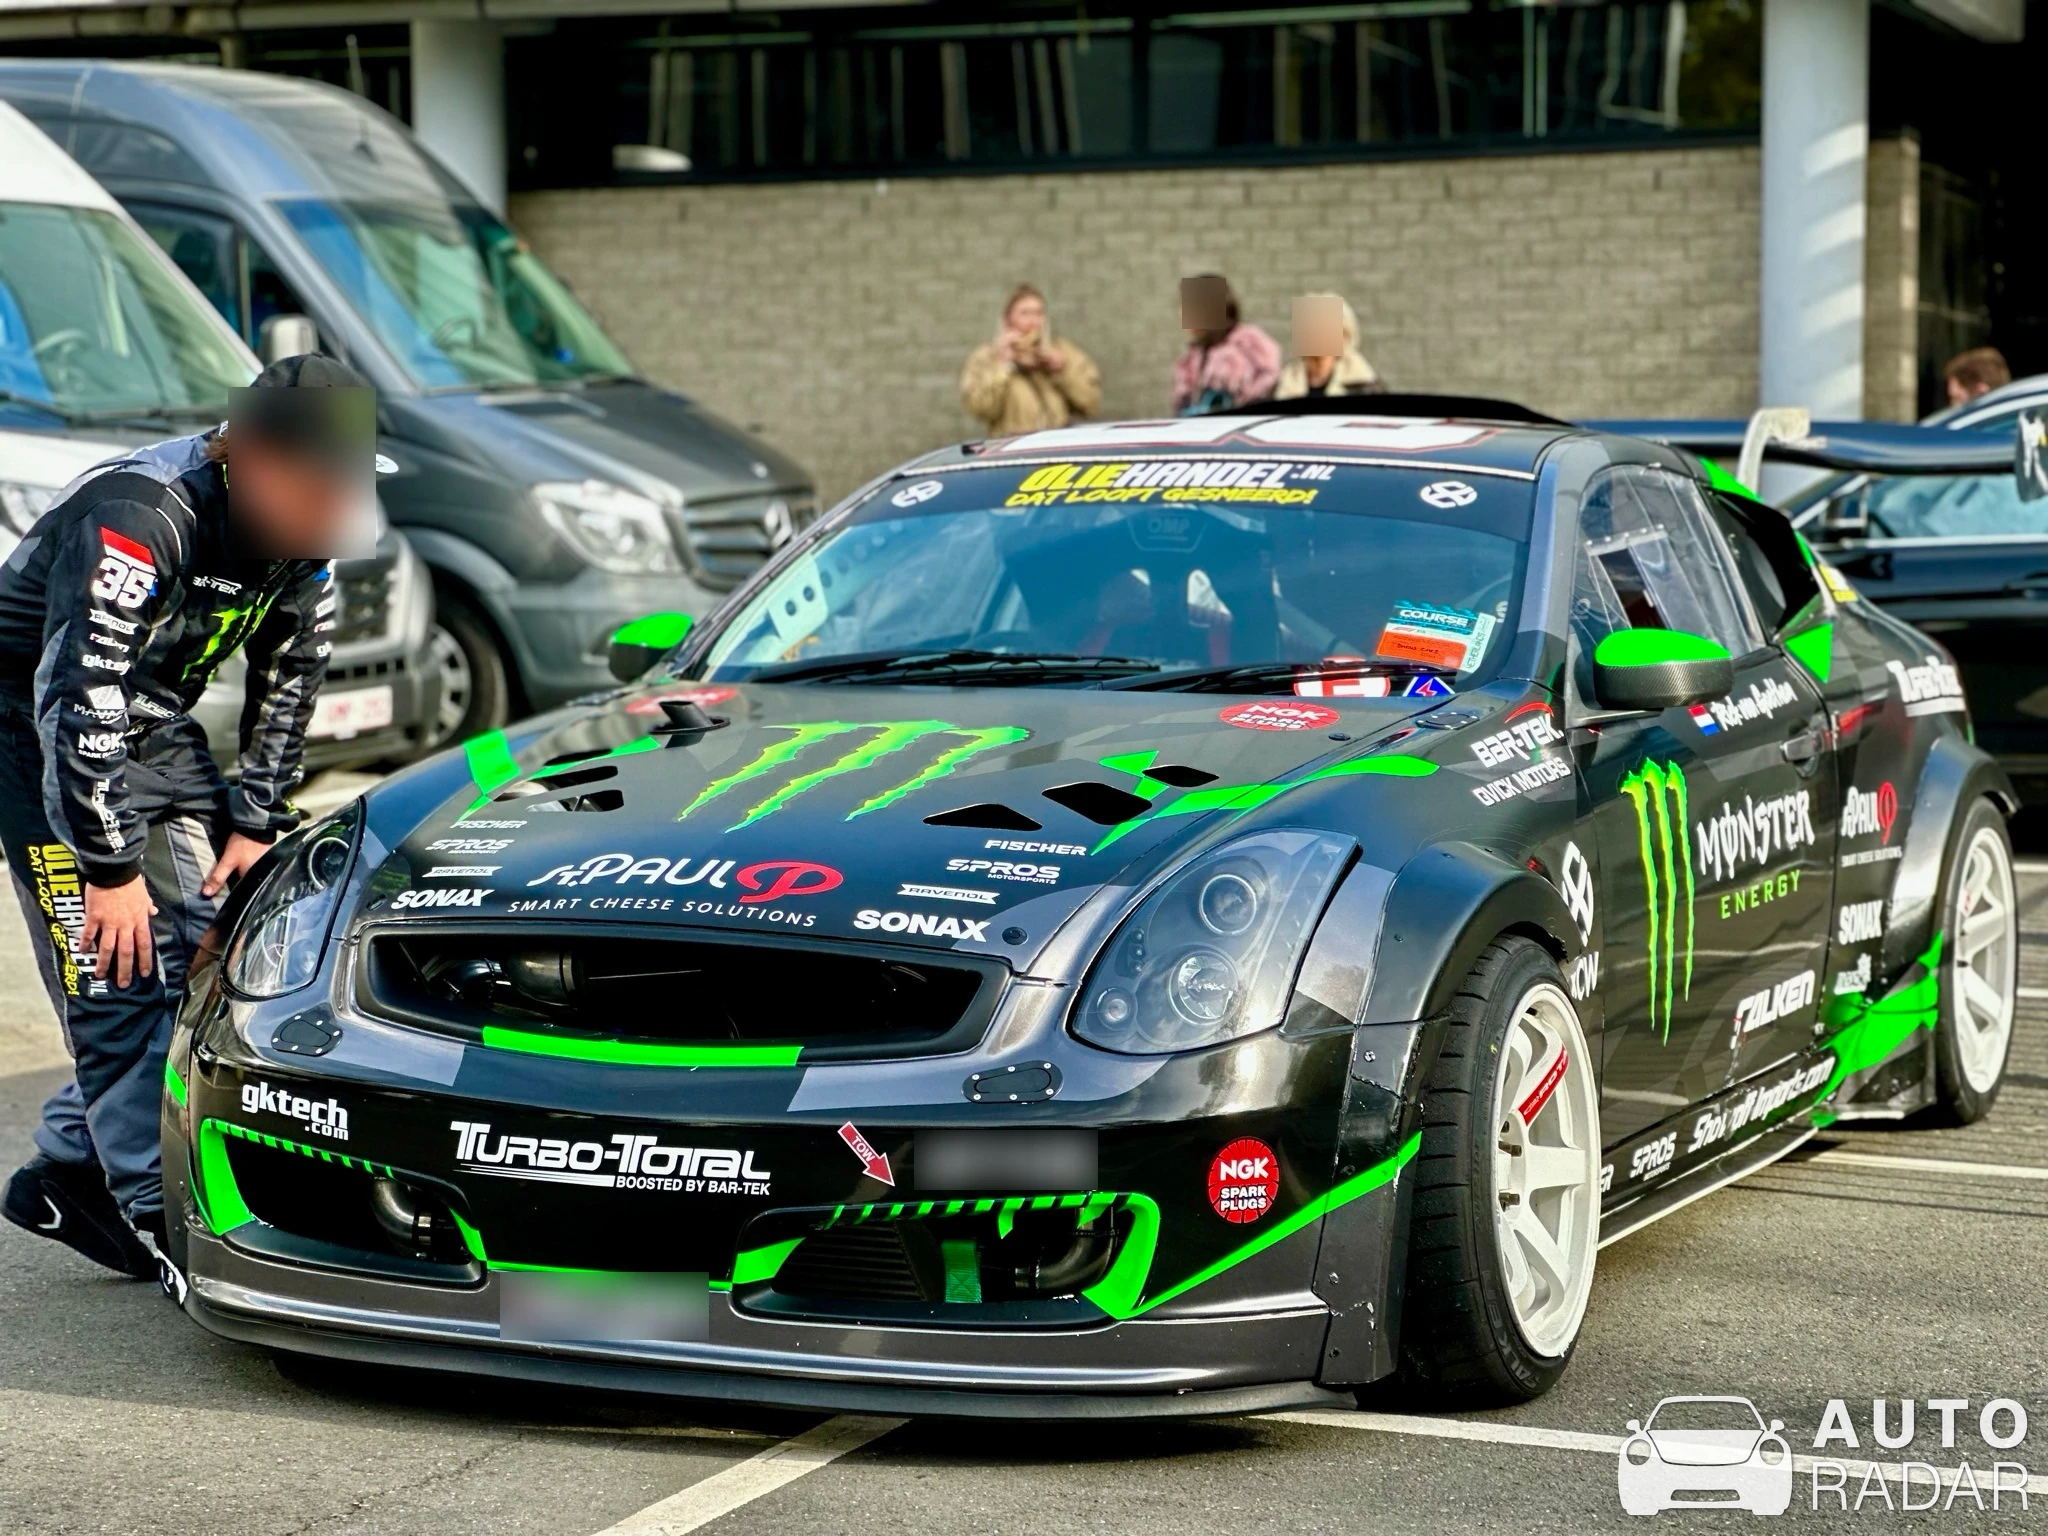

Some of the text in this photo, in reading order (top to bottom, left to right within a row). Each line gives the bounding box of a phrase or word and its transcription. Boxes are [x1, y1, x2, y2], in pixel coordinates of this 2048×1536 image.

[1005, 487, 1319, 507] DAT LOOPT GESMEERD!
[90, 557, 156, 609] 35
[1399, 609, 1469, 627] COURSE
[1246, 705, 1328, 720] NGK
[78, 732, 127, 752] NGK
[1512, 757, 1571, 792] MOTORS
[450, 820, 528, 829] FISCHER
[425, 839, 514, 850] SPROS
[984, 840, 1087, 856] FISCHER
[28, 846, 46, 876] DAT
[946, 859, 1061, 879] SPROS
[988, 874, 1057, 885] MOTORSPORTS
[391, 889, 495, 909] SONAX
[908, 887, 988, 900] RAVENOL
[1721, 869, 1800, 919] ENERGY
[507, 898, 817, 927] SMART CHEESE SOLUTIONS
[1838, 900, 1883, 945] SONAX
[853, 910, 991, 942] SONAX
[1731, 969, 1816, 1049] FALKEN
[242, 1082, 349, 1129] gktech
[303, 1120, 349, 1140] .com
[450, 1121, 771, 1180] TURBO-TOTAL
[850, 1134, 876, 1163] TOW
[1629, 1132, 1677, 1179] SPROS
[1219, 1156, 1269, 1180] NGK
[615, 1176, 771, 1196] BOOSTED BY BAR-TEK
[1220, 1186, 1267, 1199] SPARK
[1220, 1197, 1267, 1211] PLUGS
